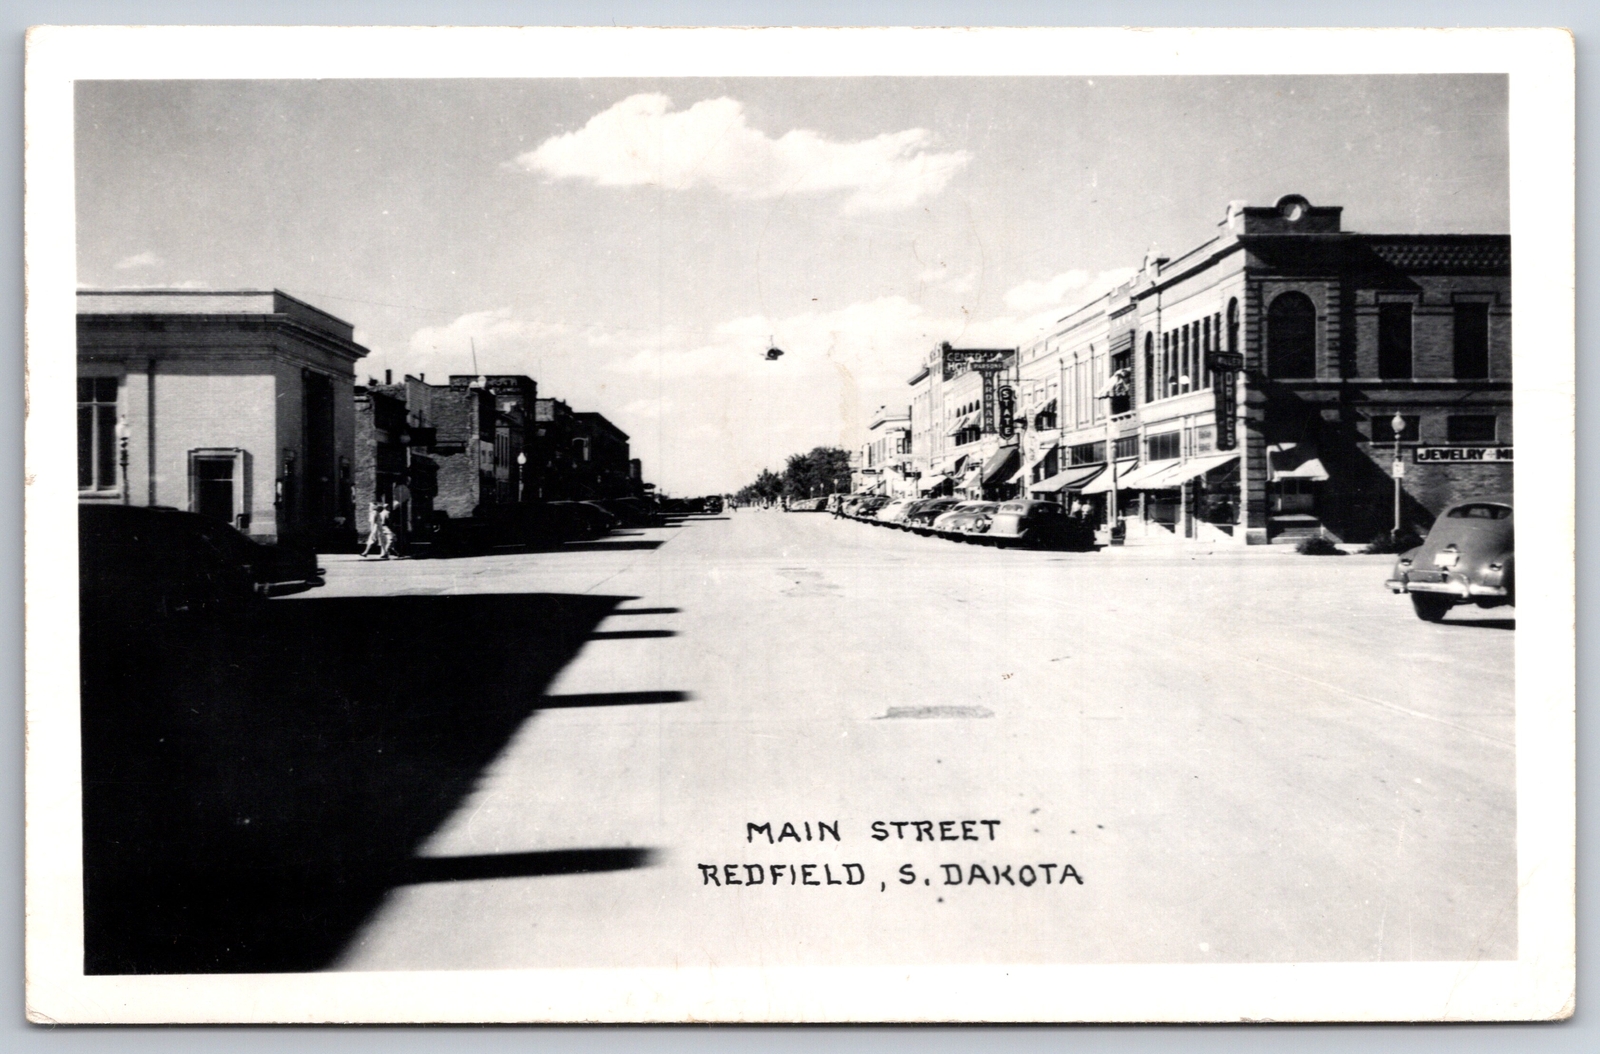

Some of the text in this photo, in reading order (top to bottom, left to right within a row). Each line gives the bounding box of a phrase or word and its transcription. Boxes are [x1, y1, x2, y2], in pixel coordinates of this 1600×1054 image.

[984, 371, 994, 432] HARDWARE
[1002, 390, 1011, 435] STATE
[1225, 371, 1235, 446] DRUGS
[1418, 448, 1486, 461] JEWELRY
